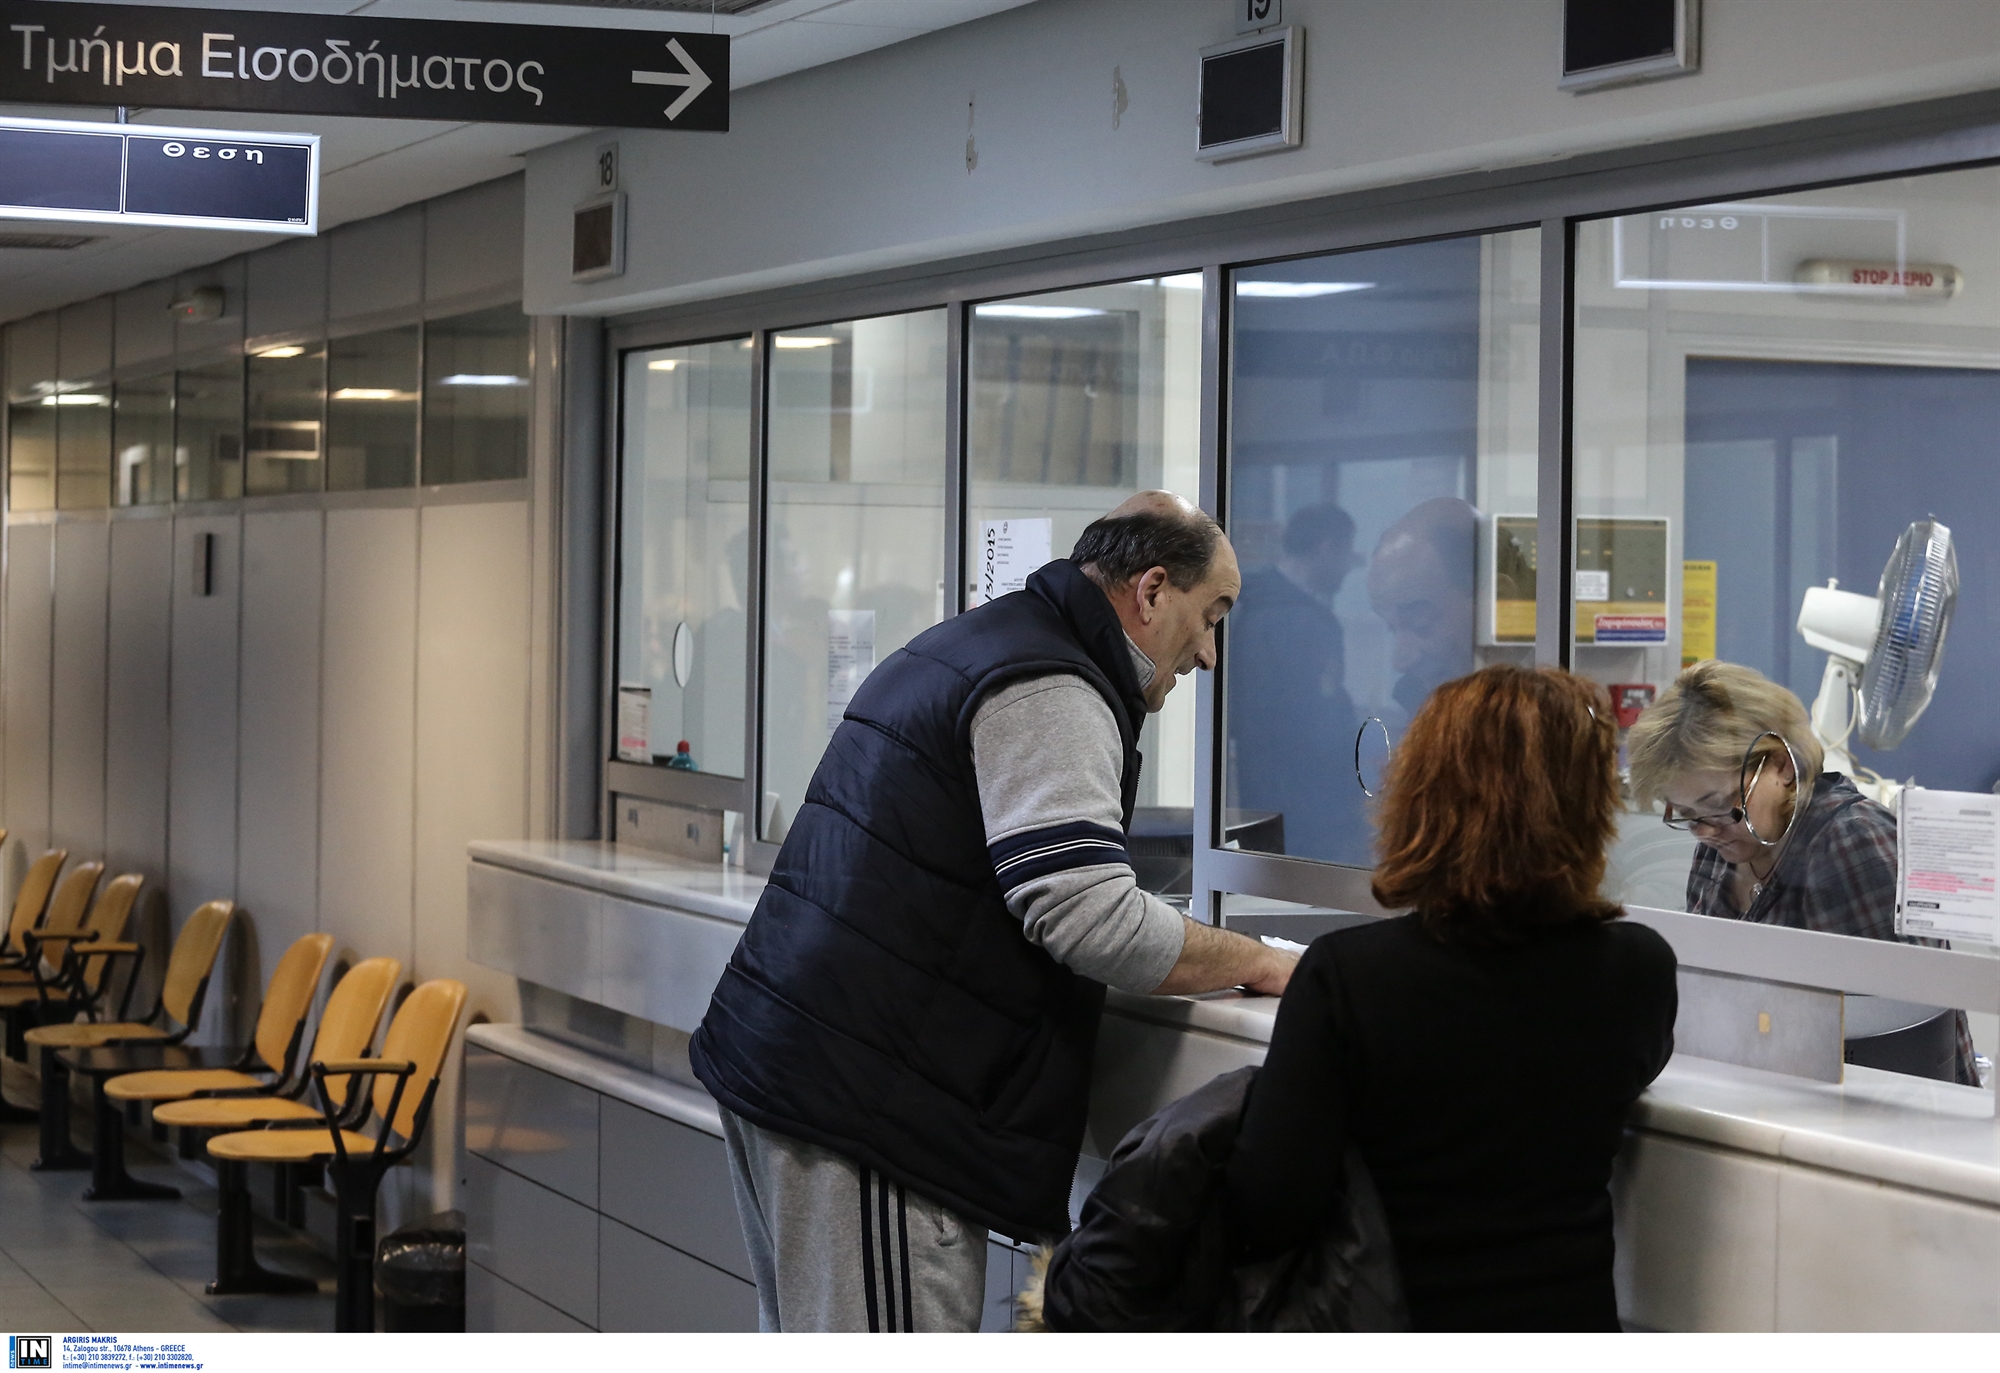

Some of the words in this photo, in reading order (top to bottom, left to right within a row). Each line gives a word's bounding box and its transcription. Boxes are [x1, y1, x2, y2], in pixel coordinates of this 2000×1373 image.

[10, 25, 182, 85] Τμήμα
[202, 33, 545, 106] Εισοδήματος
[162, 142, 264, 165] Θεση
[600, 150, 613, 186] 18
[1852, 269, 1889, 285] STOP
